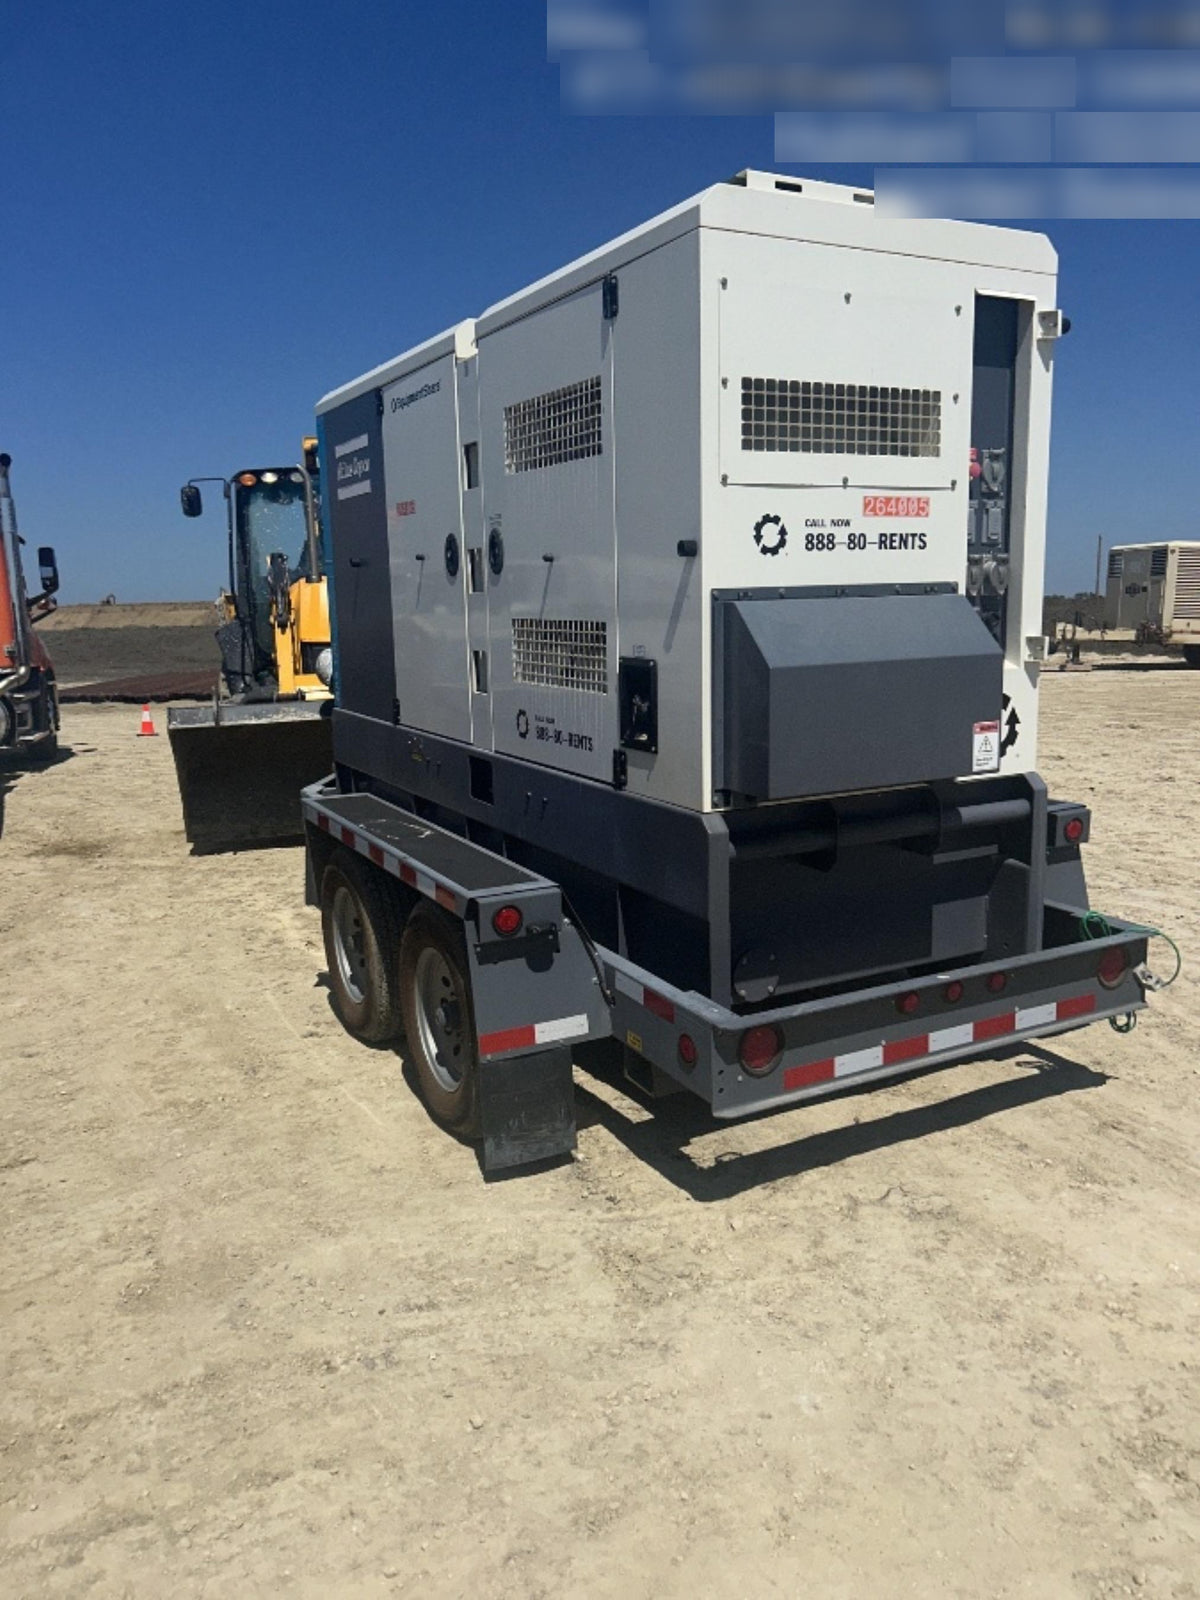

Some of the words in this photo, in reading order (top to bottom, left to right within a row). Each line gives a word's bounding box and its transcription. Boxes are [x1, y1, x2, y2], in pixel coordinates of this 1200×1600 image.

[864, 497, 928, 516] 264005
[805, 519, 826, 527] CALL
[830, 519, 851, 528] NOW
[804, 533, 927, 551] 888-80-RENTS
